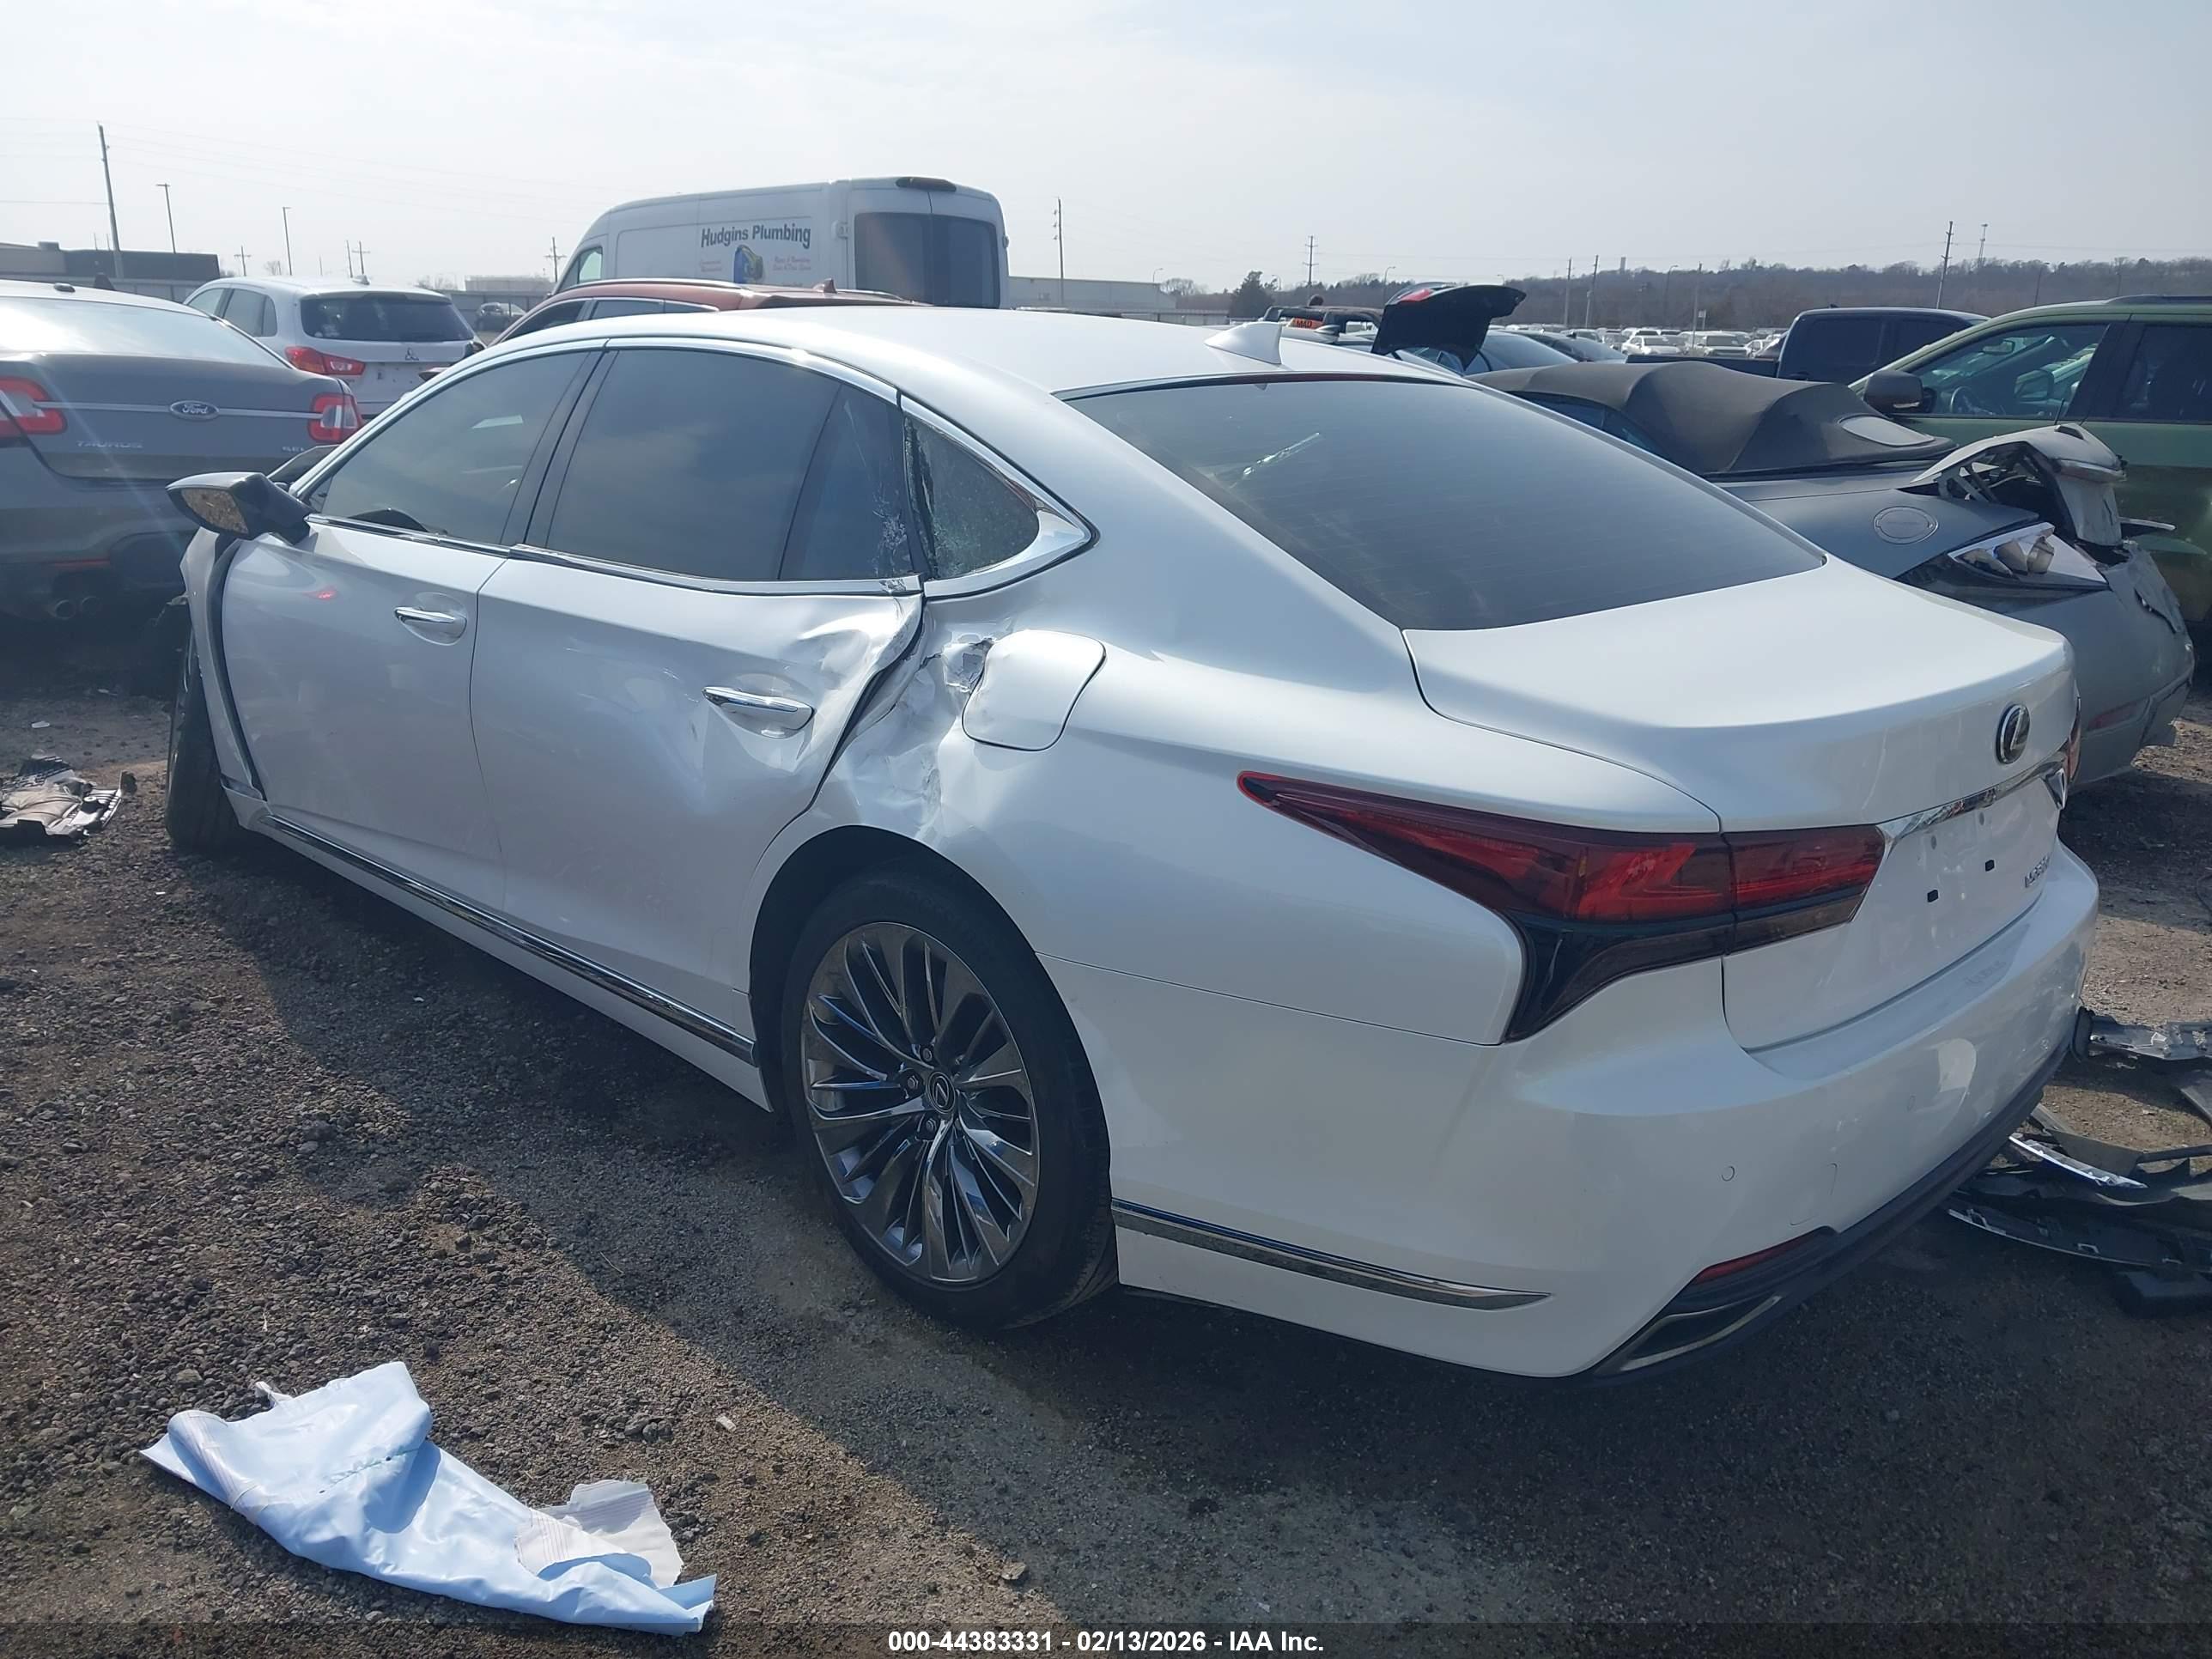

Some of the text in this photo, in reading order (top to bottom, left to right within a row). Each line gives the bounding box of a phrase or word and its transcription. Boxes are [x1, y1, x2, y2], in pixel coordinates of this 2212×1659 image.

[701, 222, 811, 249] Hudgins Plumbing
[182, 404, 208, 414] Ford
